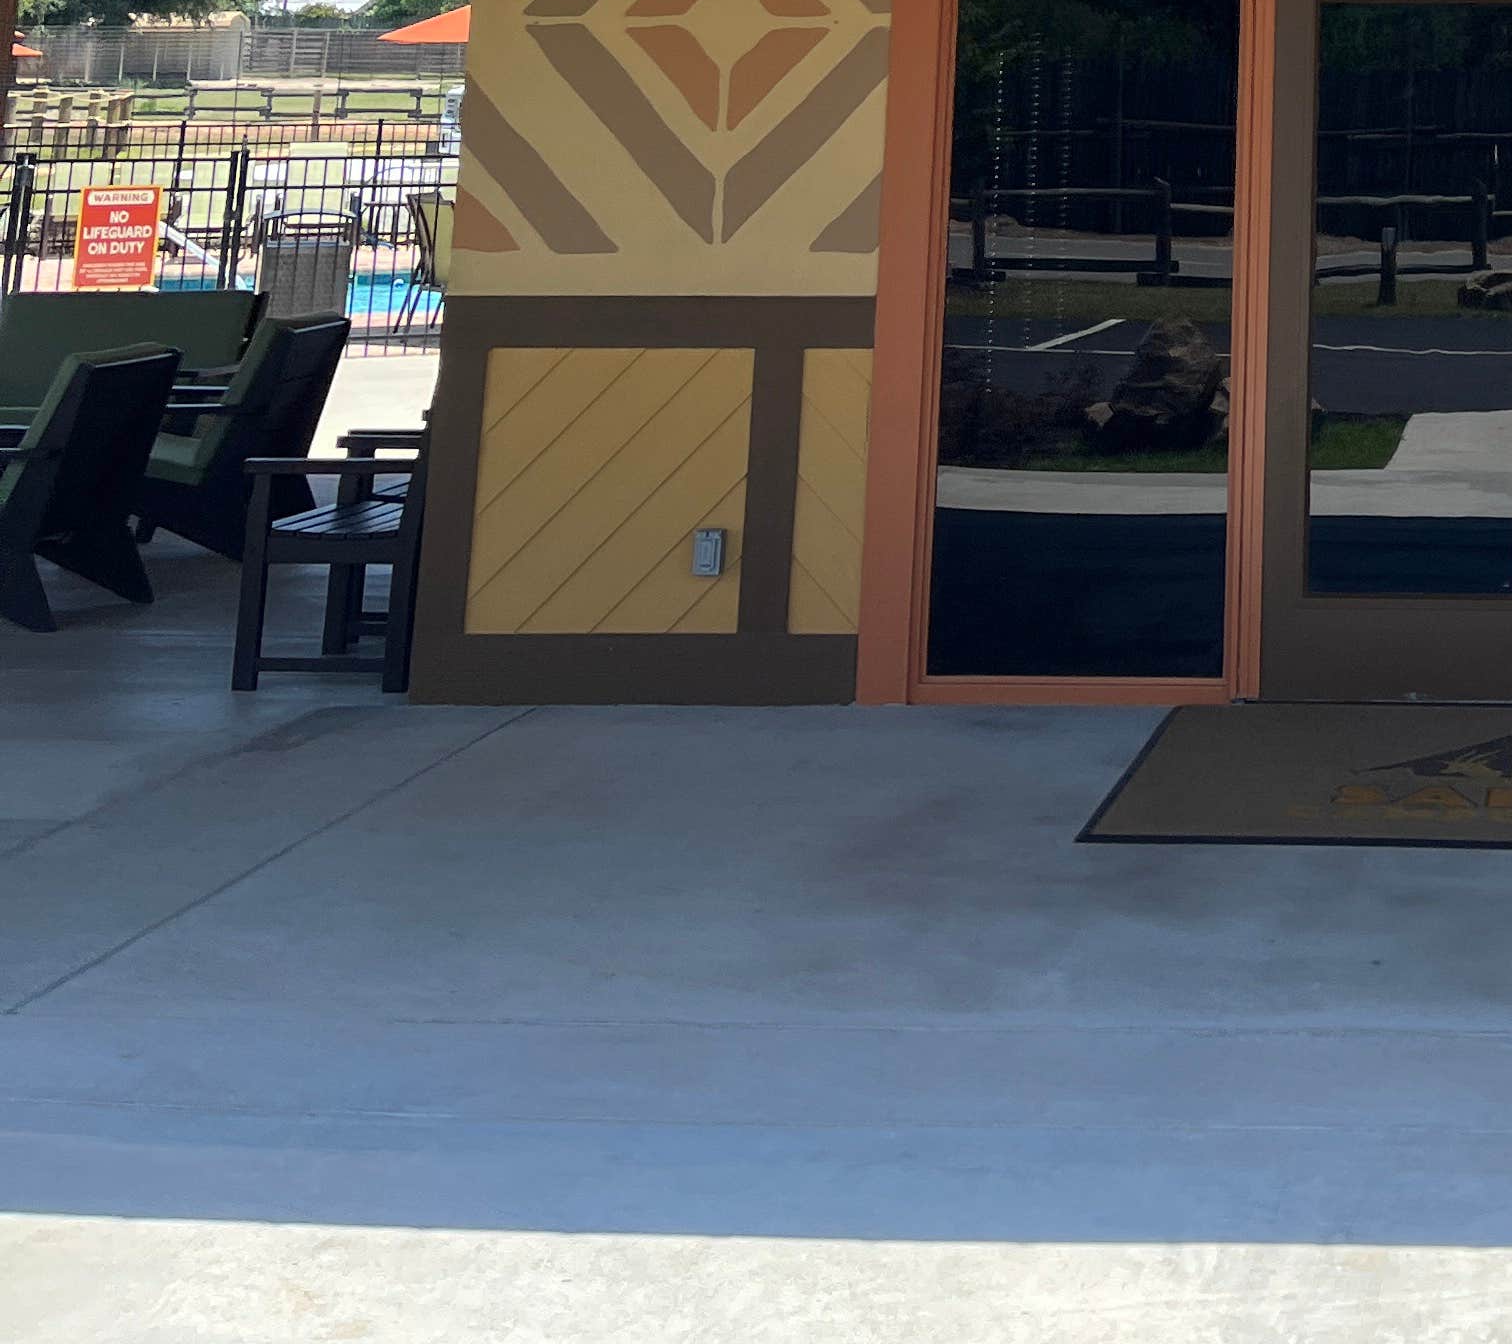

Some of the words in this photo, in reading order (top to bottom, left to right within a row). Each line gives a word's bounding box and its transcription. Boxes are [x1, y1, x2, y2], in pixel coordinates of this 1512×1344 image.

[94, 192, 149, 202] WARNING
[109, 210, 130, 224] NO
[82, 225, 153, 240] LIFEGUARD
[87, 242, 107, 255] ON
[110, 241, 145, 255] DUTY
